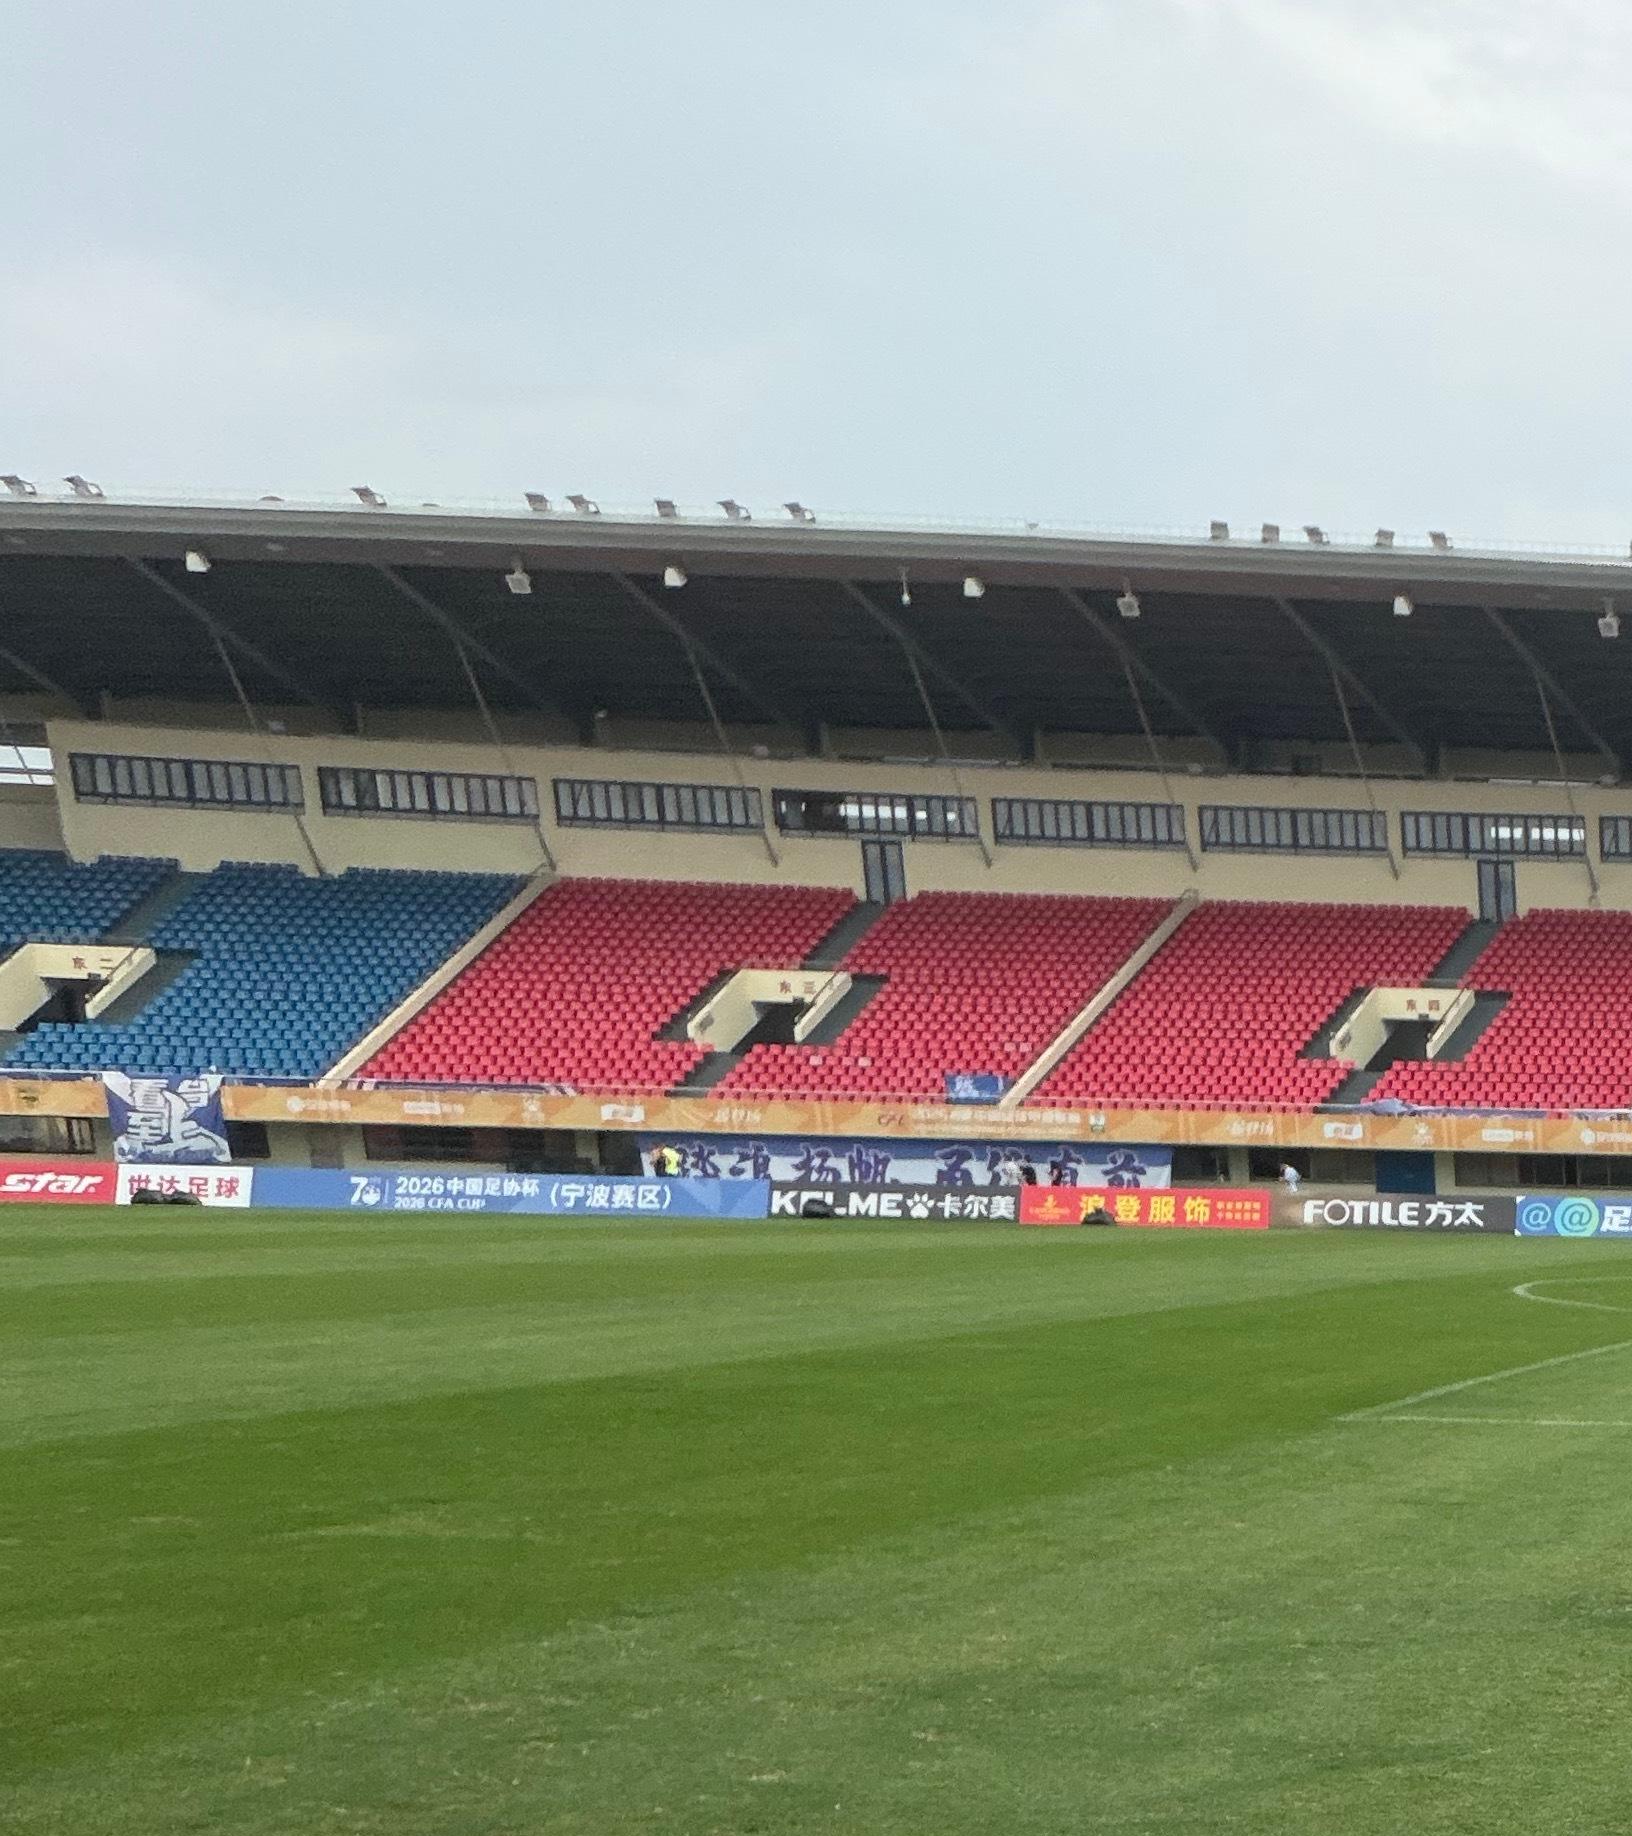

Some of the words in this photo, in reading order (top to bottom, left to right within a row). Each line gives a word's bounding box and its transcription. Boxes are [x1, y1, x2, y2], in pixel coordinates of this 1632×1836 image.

[395, 1175, 540, 1197] 2026中国足协杯
[937, 1193, 1016, 1220] 卡尔美
[1303, 1199, 1420, 1226] FOTILE
[1425, 1201, 1484, 1227] 方太
